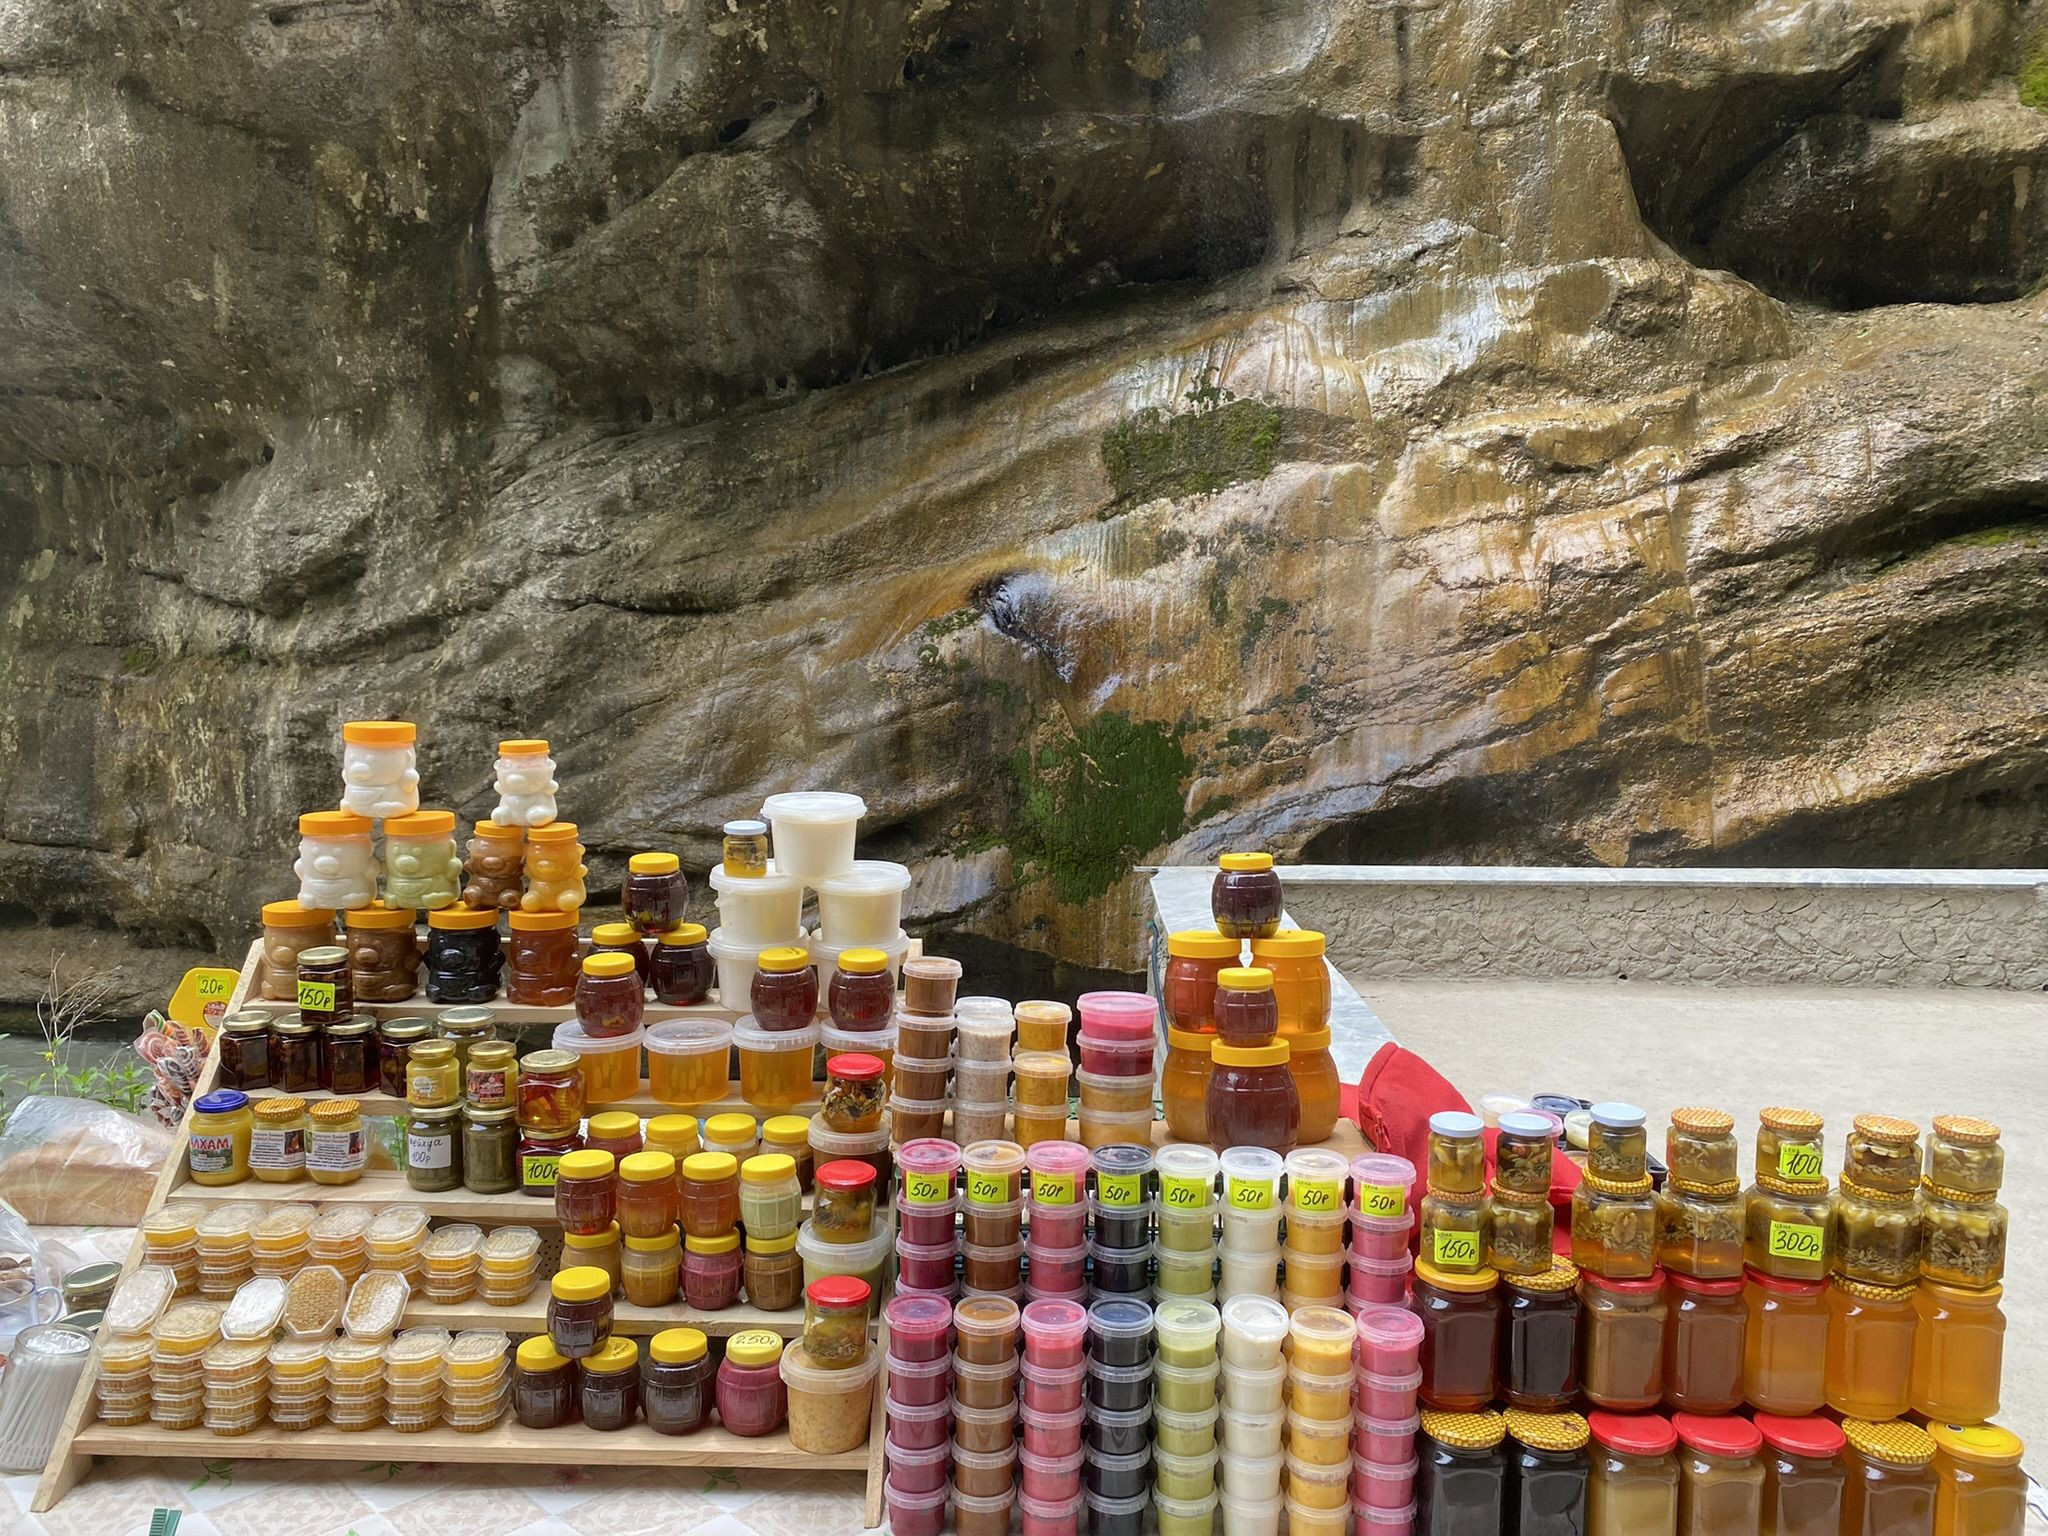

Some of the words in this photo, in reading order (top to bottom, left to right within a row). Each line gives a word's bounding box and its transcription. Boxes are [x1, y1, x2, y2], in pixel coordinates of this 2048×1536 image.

[200, 979, 223, 994] 20р
[299, 988, 331, 1008] 150р
[911, 1183, 938, 1199] 50р
[973, 1181, 998, 1198] 50р
[1038, 1183, 1064, 1198] 50р
[1105, 1185, 1130, 1200] 50р
[1169, 1187, 1196, 1203] 50р
[1236, 1188, 1263, 1203] 50р
[1302, 1190, 1329, 1205] 50р
[1369, 1195, 1395, 1210] 50р
[1440, 1239, 1475, 1259] 150р
[1775, 1230, 1819, 1256] 300р
